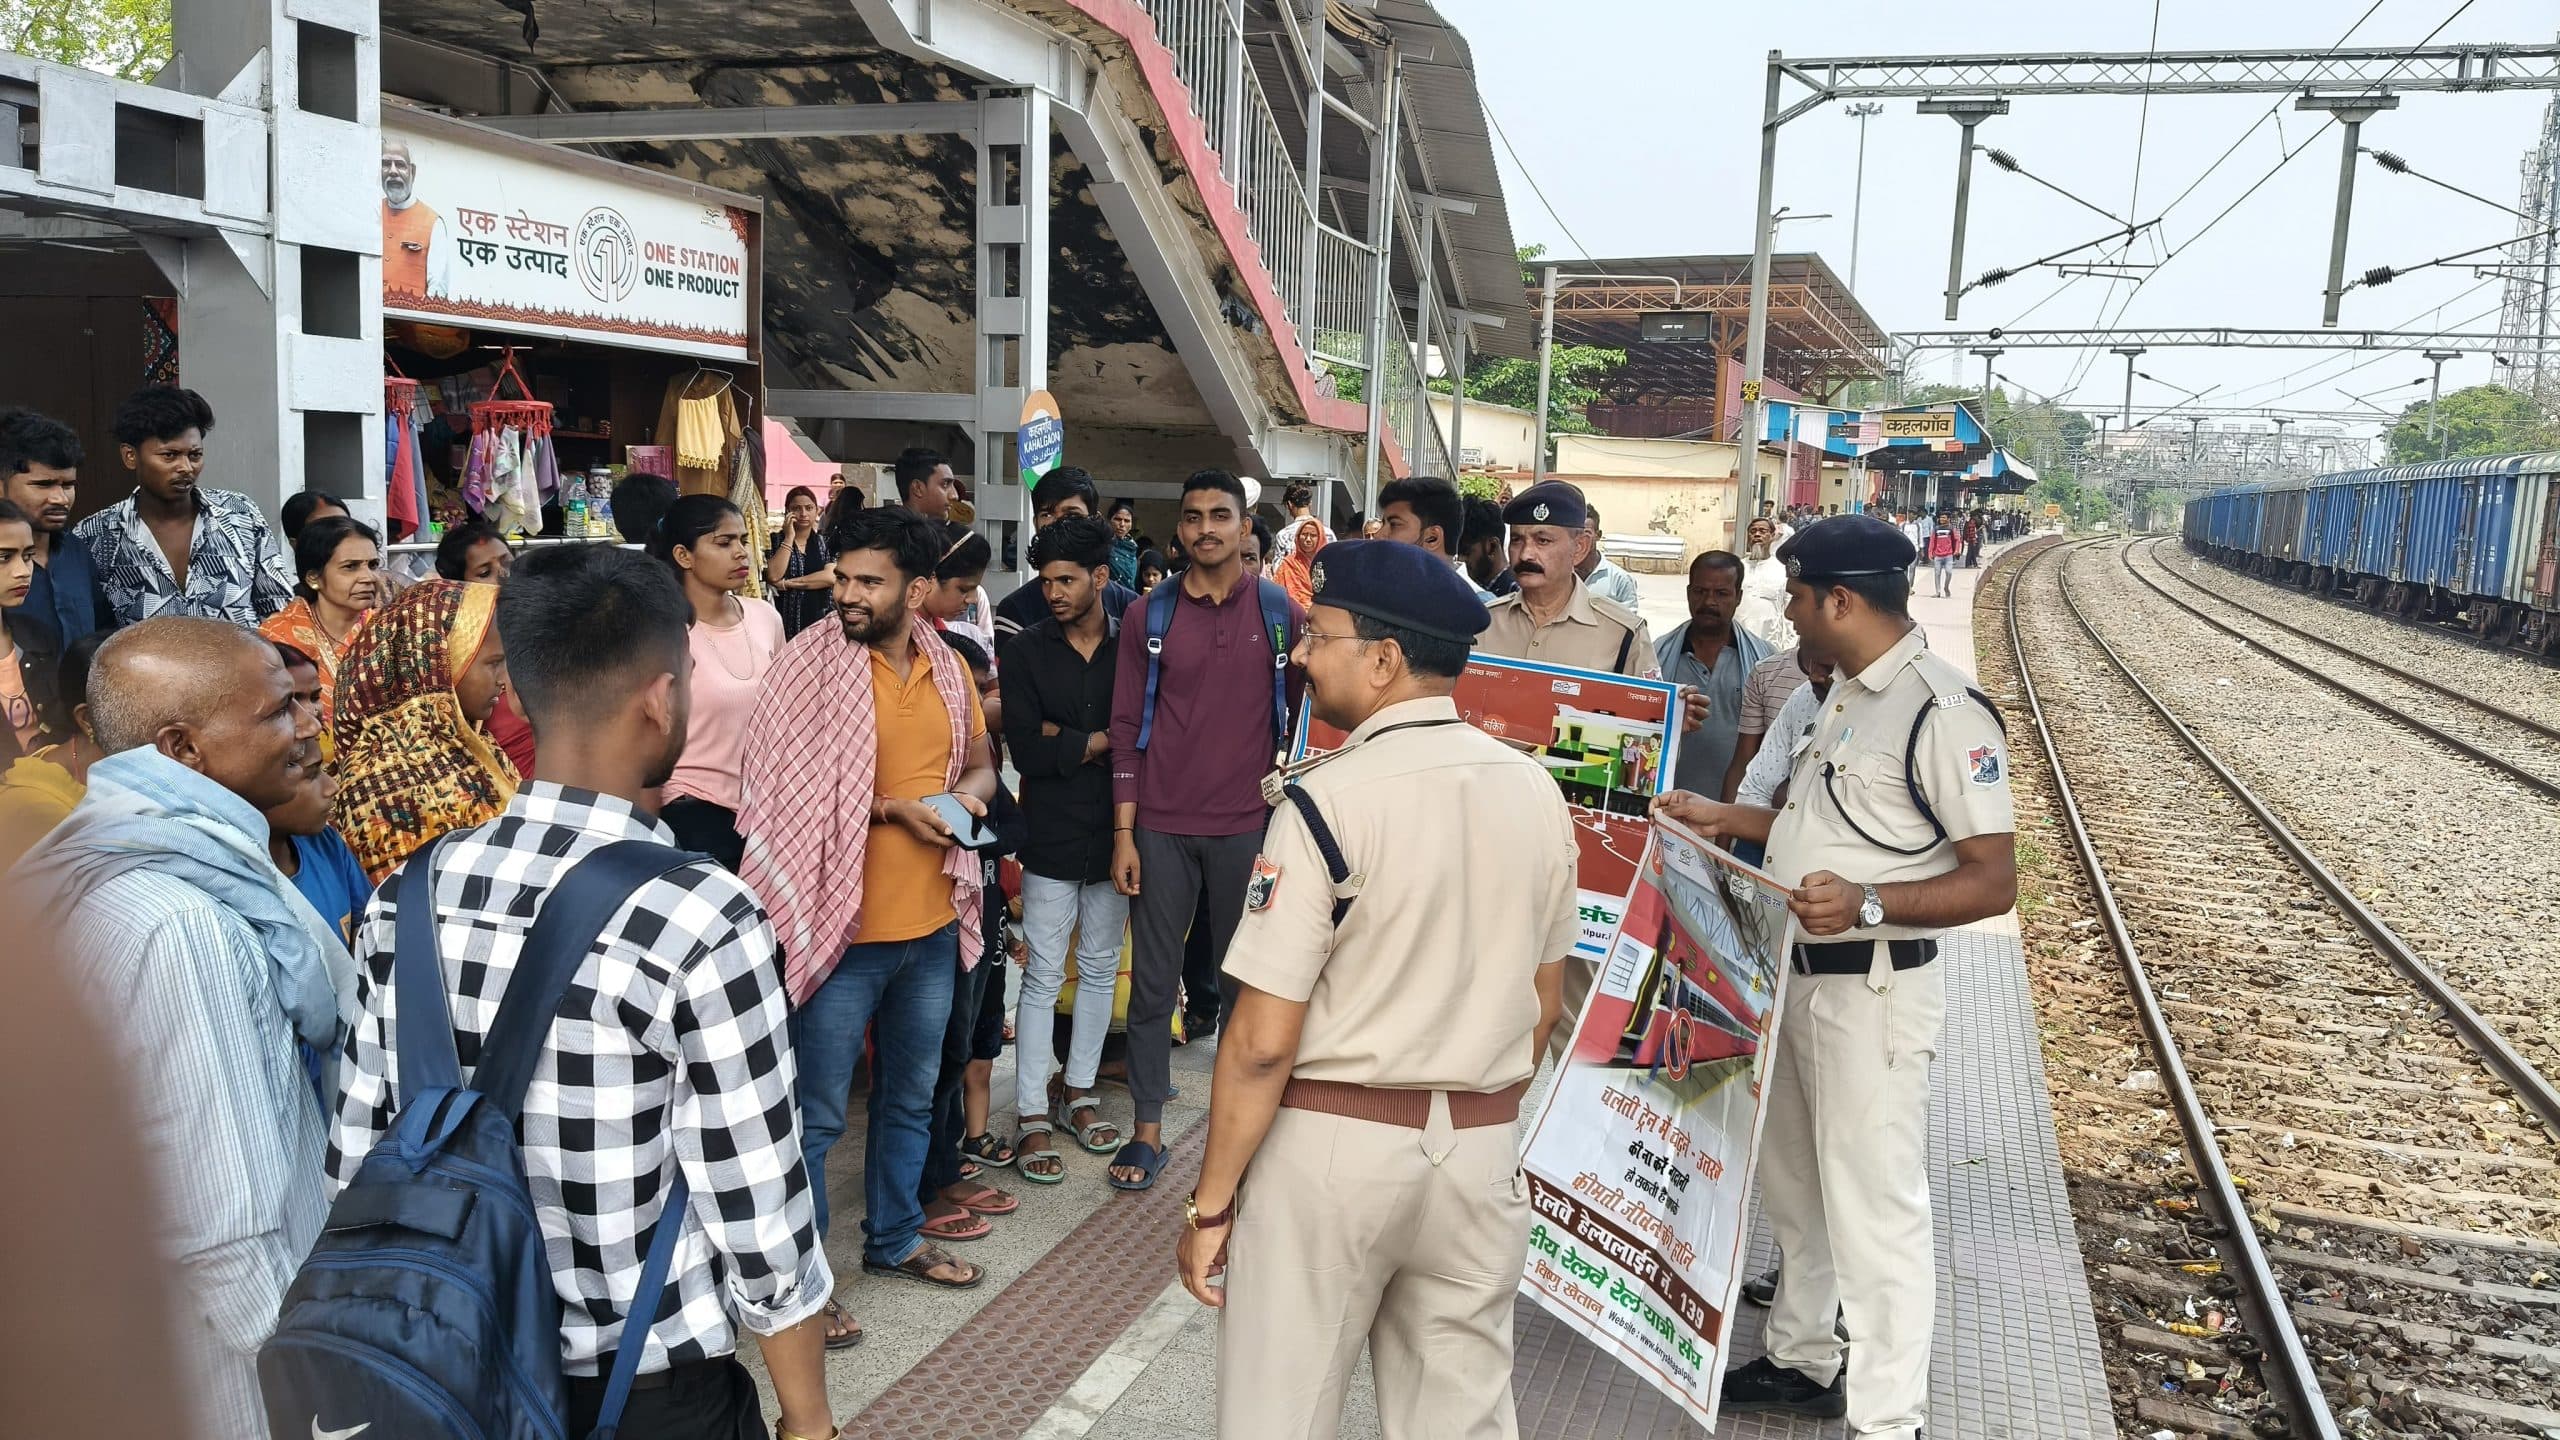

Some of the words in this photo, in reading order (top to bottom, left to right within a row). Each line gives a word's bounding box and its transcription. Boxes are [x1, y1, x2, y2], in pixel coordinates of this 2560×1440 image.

[456, 207, 498, 237] एक
[504, 209, 569, 247] स्टेशन
[457, 238, 499, 267] एक
[504, 245, 569, 279] उत्पाद
[644, 240, 676, 265] ONE
[680, 247, 739, 276] STATION
[644, 267, 674, 289] ONE
[678, 272, 740, 299] PRODUCT
[1742, 381, 1759, 391] 275
[1744, 391, 1756, 400] 26
[1885, 414, 1951, 435] कहलगाँव
[1023, 430, 1061, 454] KAHALGAON
[1577, 905, 1619, 924] संघ
[1601, 1086, 1641, 1121] चलती
[1635, 1102, 1660, 1133] ट्रेन
[1658, 1114, 1673, 1140] में
[1628, 1140, 1644, 1159] की
[1641, 1149, 1654, 1167] ना
[1624, 1166, 1637, 1183] हो
[1634, 1173, 1660, 1199] सकती
[1620, 1200, 1663, 1238] जीवन
[1660, 1224, 1675, 1250] की
[1671, 1237, 1697, 1272] हानि
[1534, 1179, 1575, 1226] रेलवे
[1577, 1208, 1660, 1282] हेल्पलाईन
[1680, 1292, 1705, 1330] 139
[1534, 1258, 1563, 1292] विष्णु
[1563, 1280, 1606, 1316] खेतान
[1561, 1246, 1610, 1290] रेलवे
[1609, 1277, 1644, 1313] रेल
[1643, 1303, 1676, 1344] यात्री
[1678, 1335, 1704, 1371] संघ
[1608, 1310, 1637, 1335] Website
